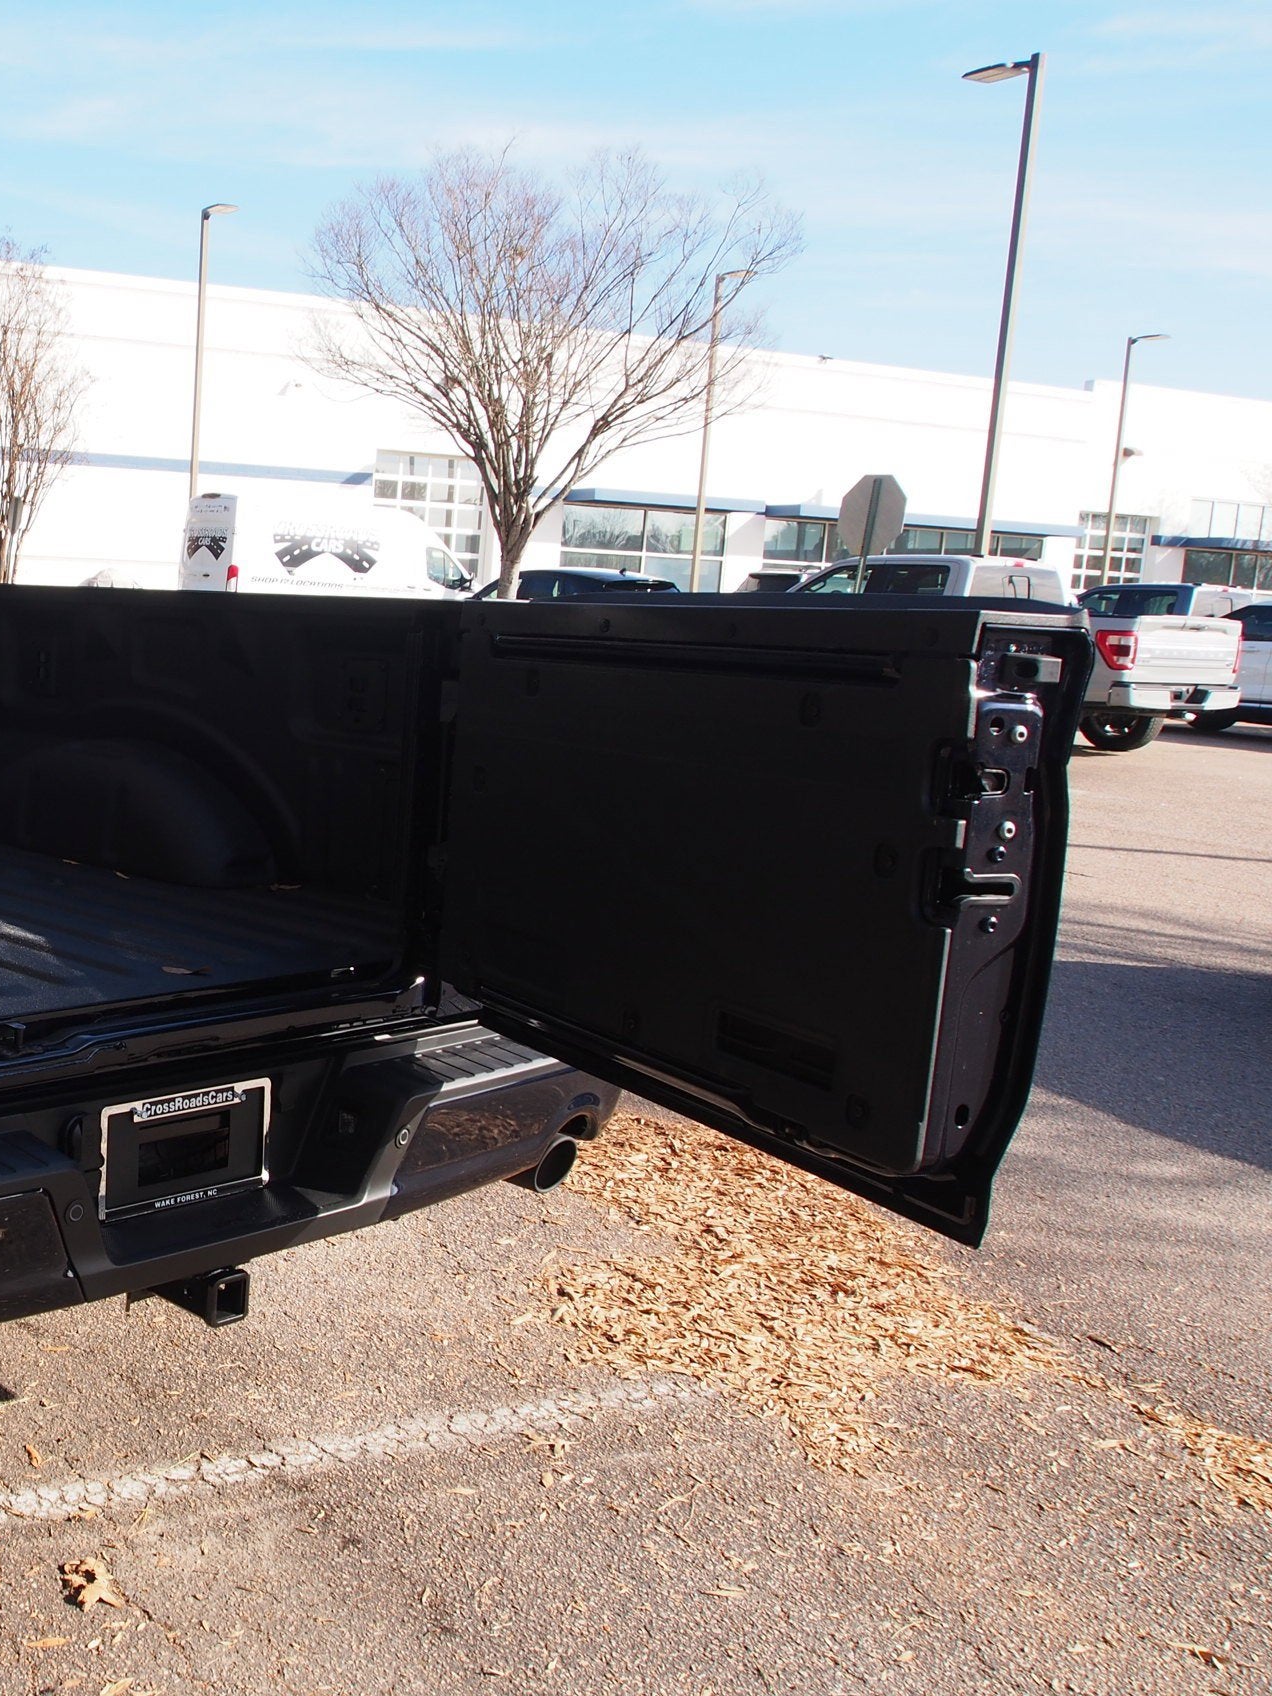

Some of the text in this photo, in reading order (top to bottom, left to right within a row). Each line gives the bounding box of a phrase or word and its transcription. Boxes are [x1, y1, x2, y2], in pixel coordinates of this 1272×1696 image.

[311, 537, 344, 553] CARS
[142, 1090, 234, 1118] CrossRoadsCars
[154, 1188, 218, 1208] WAKE FOREST, NC
